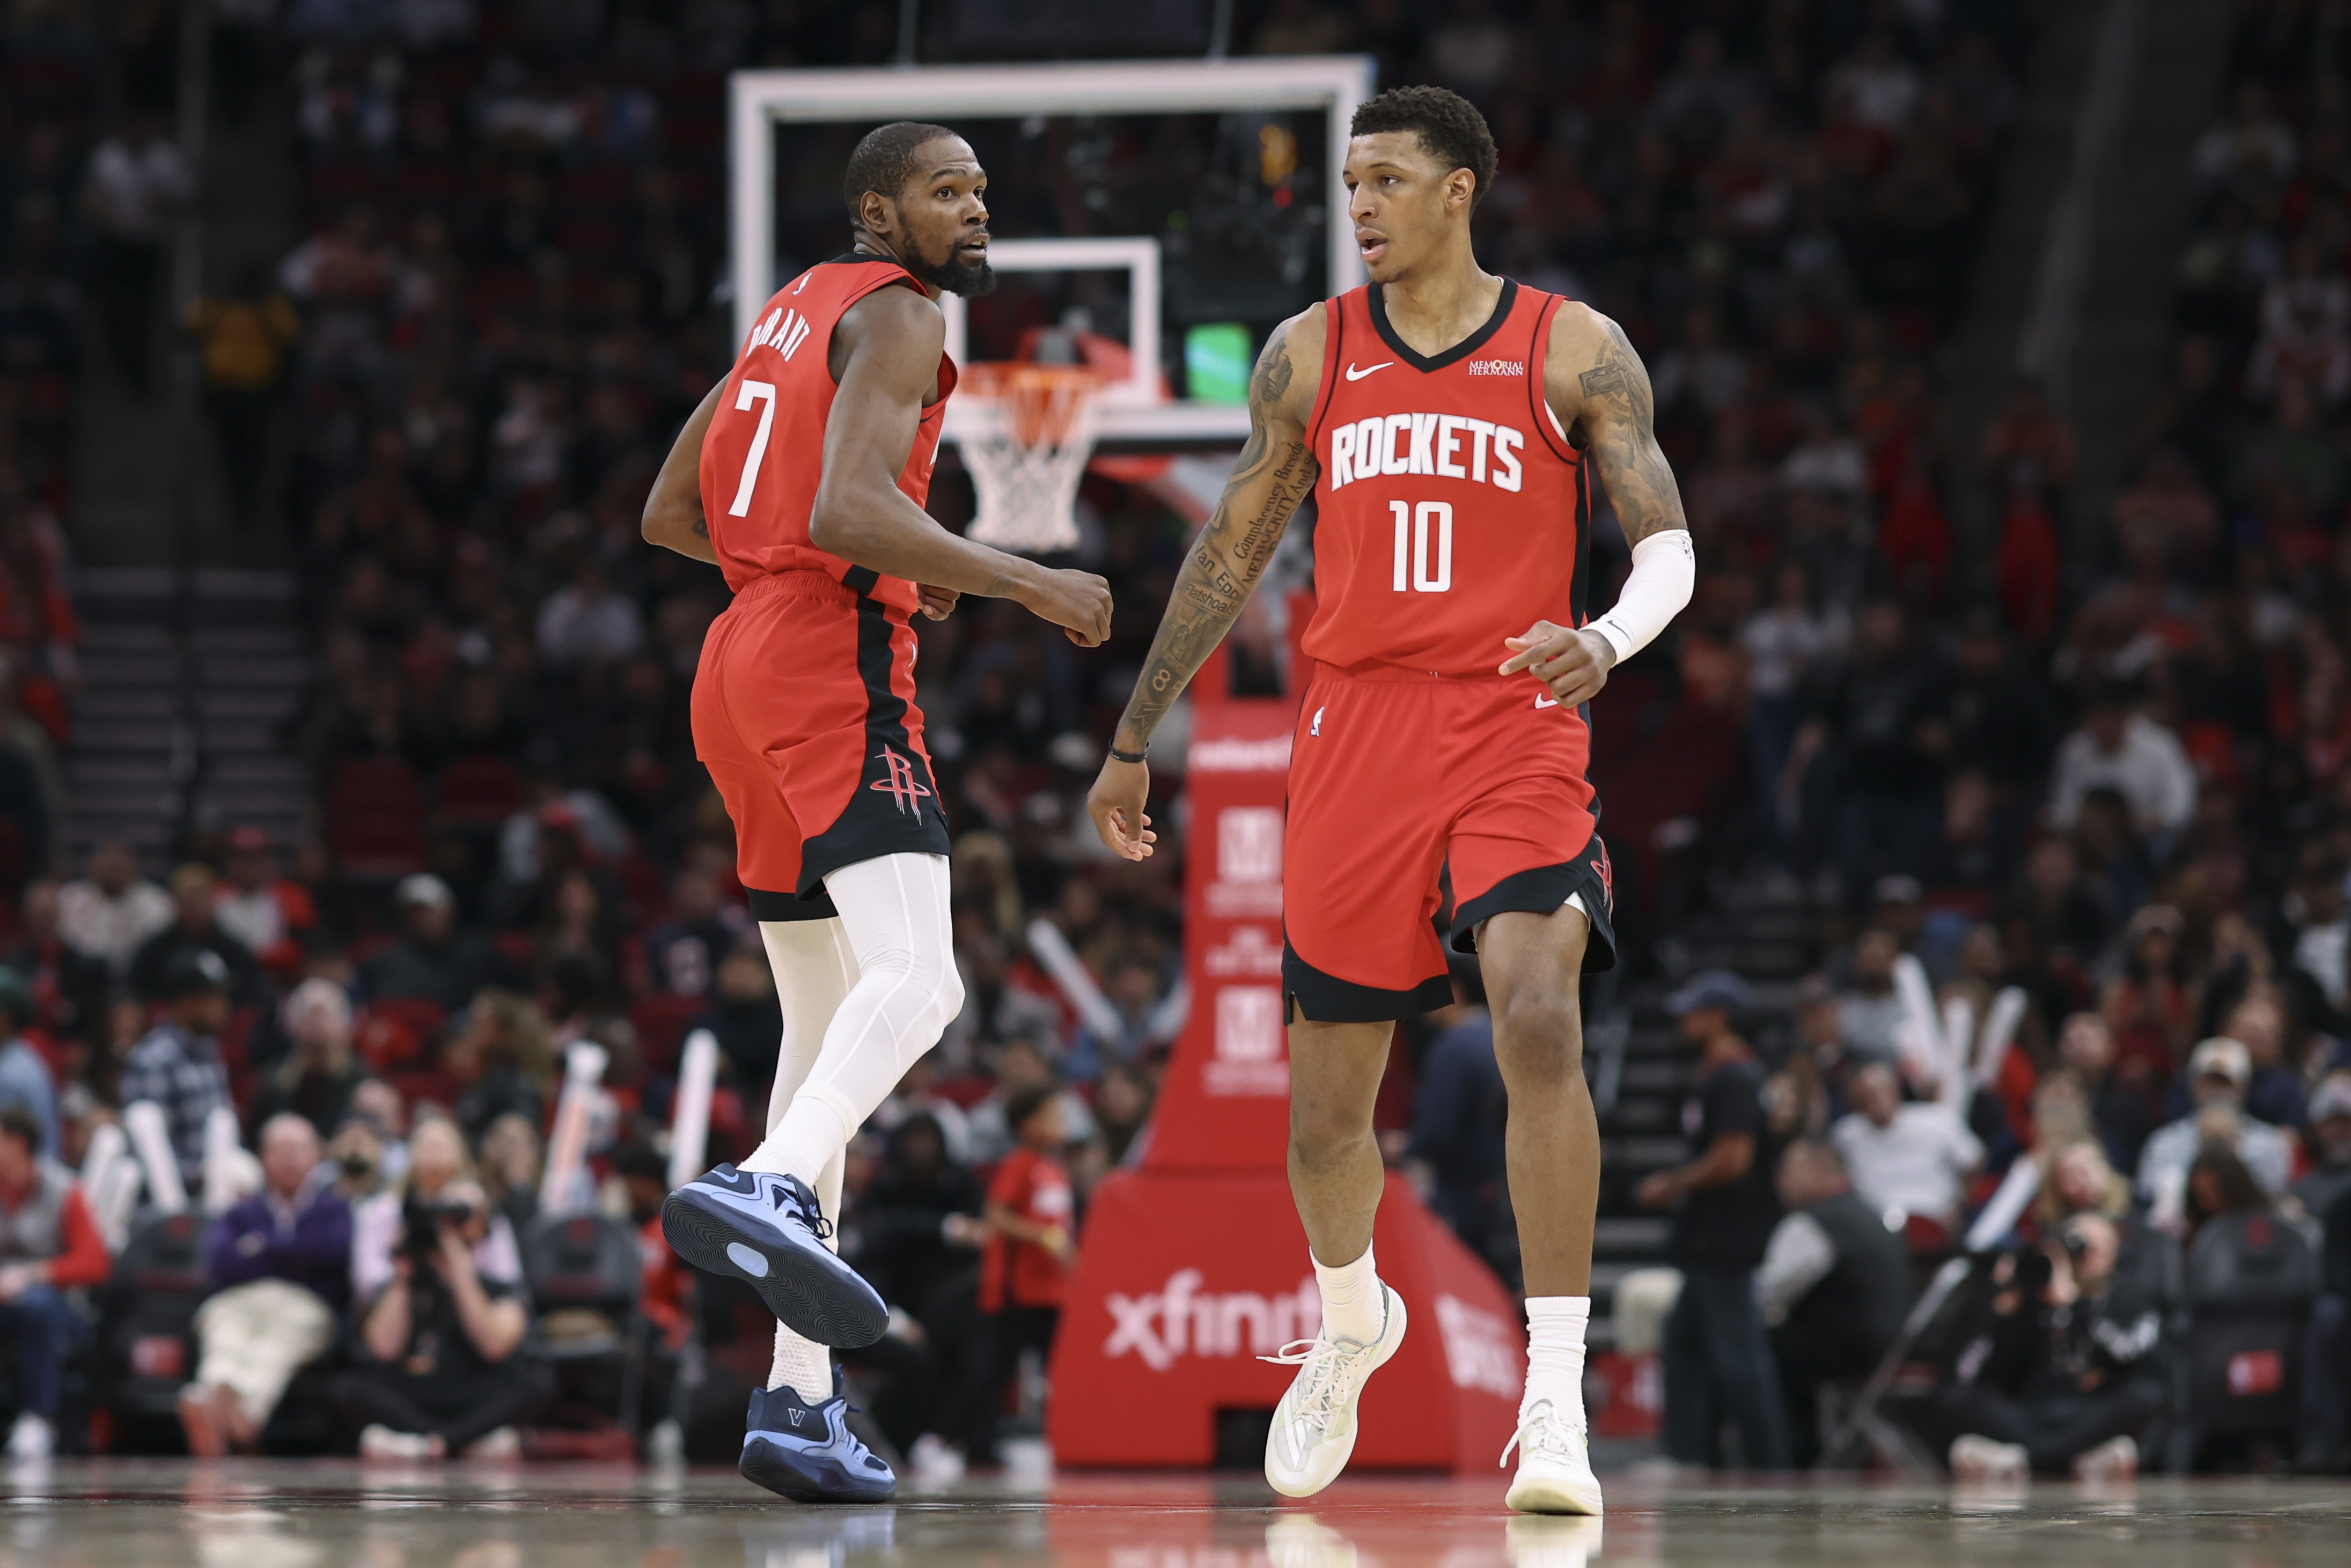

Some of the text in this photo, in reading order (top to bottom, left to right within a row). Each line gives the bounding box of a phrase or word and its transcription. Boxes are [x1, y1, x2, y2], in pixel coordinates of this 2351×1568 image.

[1469, 359, 1524, 370] MEMORIAL
[1469, 367, 1524, 376] HERMANN
[729, 379, 776, 518] 7
[1331, 412, 1524, 494] ROCKETS
[1233, 482, 1287, 560] Complacency
[1273, 440, 1304, 480] Breeds
[1241, 489, 1295, 585] MEDIOCRITY
[1289, 469, 1311, 494] And
[1194, 541, 1215, 572] Van
[1388, 499, 1453, 593] 10
[1186, 583, 1237, 615] Flatshoals
[1104, 1267, 1322, 1373] xfinit
[788, 1408, 806, 1427] V
